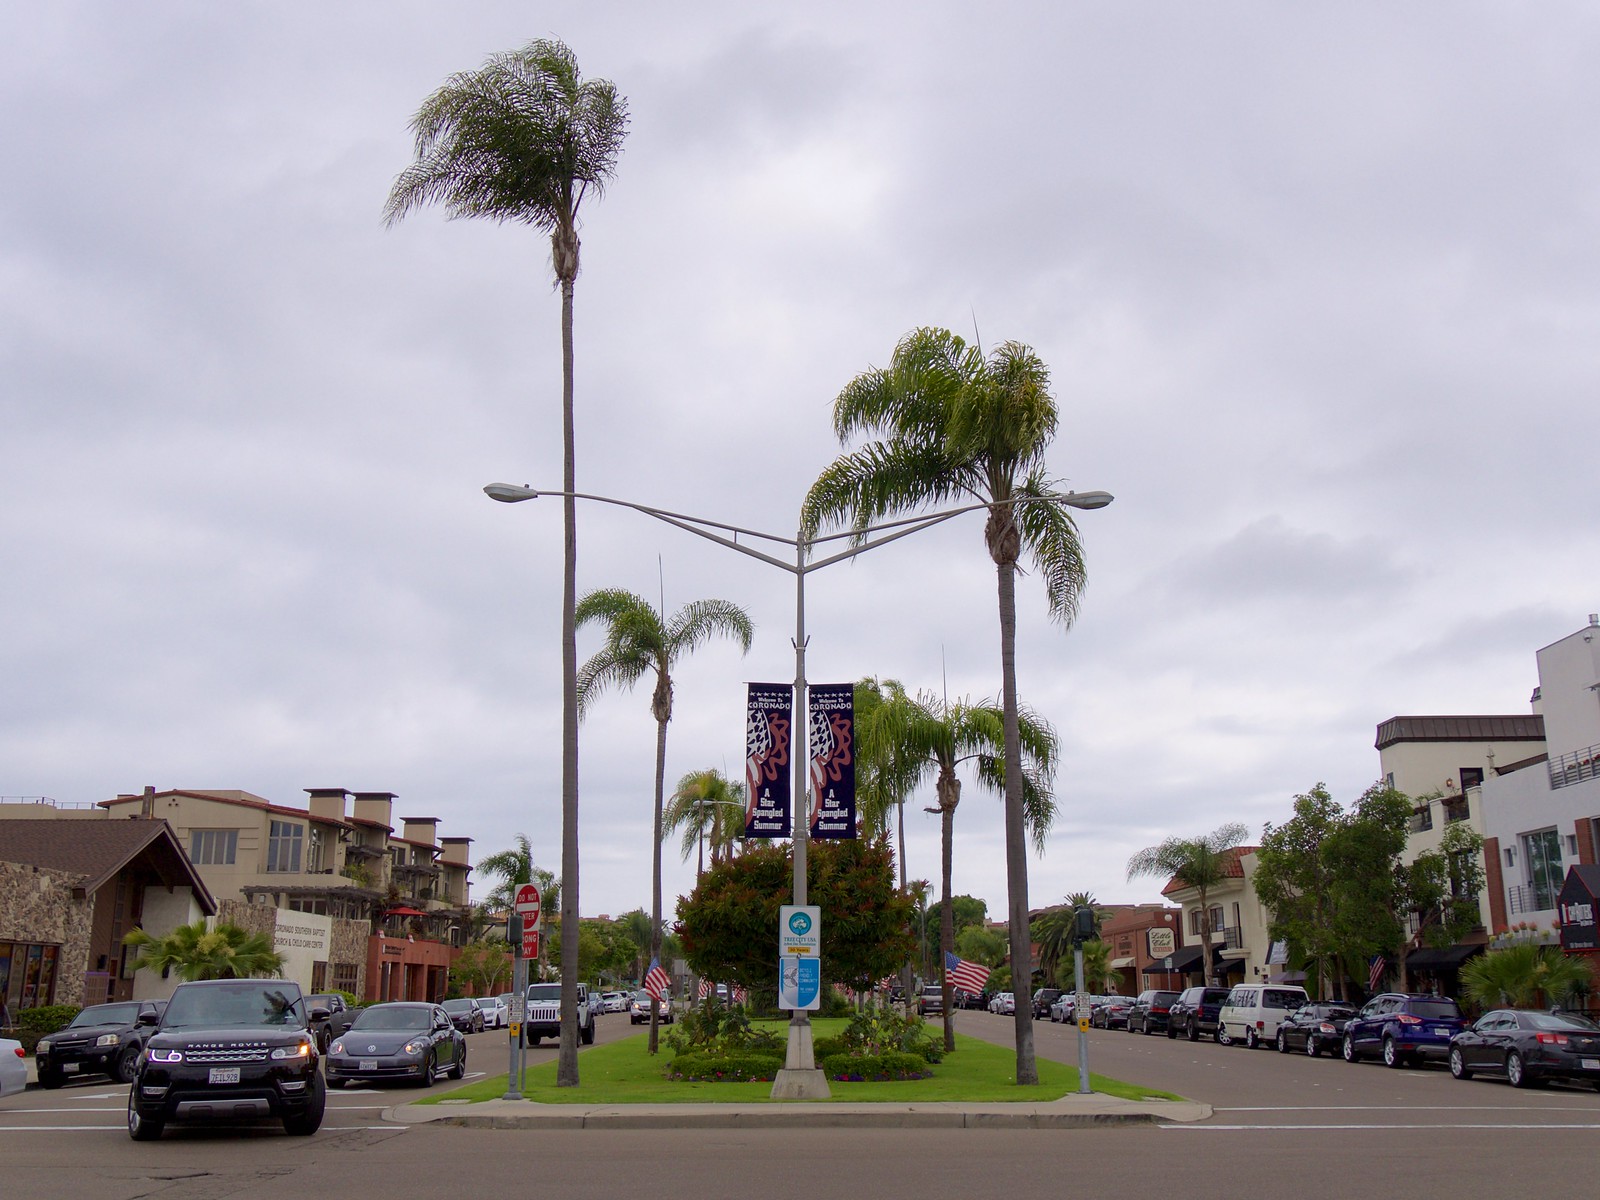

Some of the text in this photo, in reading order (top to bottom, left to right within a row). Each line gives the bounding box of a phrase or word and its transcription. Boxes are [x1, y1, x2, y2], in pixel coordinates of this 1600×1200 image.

[764, 788, 770, 797] A
[829, 789, 834, 798] A
[760, 798, 775, 807] Star
[825, 799, 840, 807] Star
[752, 808, 783, 818] Spangled
[818, 808, 848, 819] Spangled
[754, 821, 782, 829] Summer
[819, 821, 847, 830] Summer
[275, 924, 294, 934] CORONADO
[274, 937, 288, 946] CHURCH
[1151, 938, 1171, 947] Club
[523, 946, 532, 955] AY
